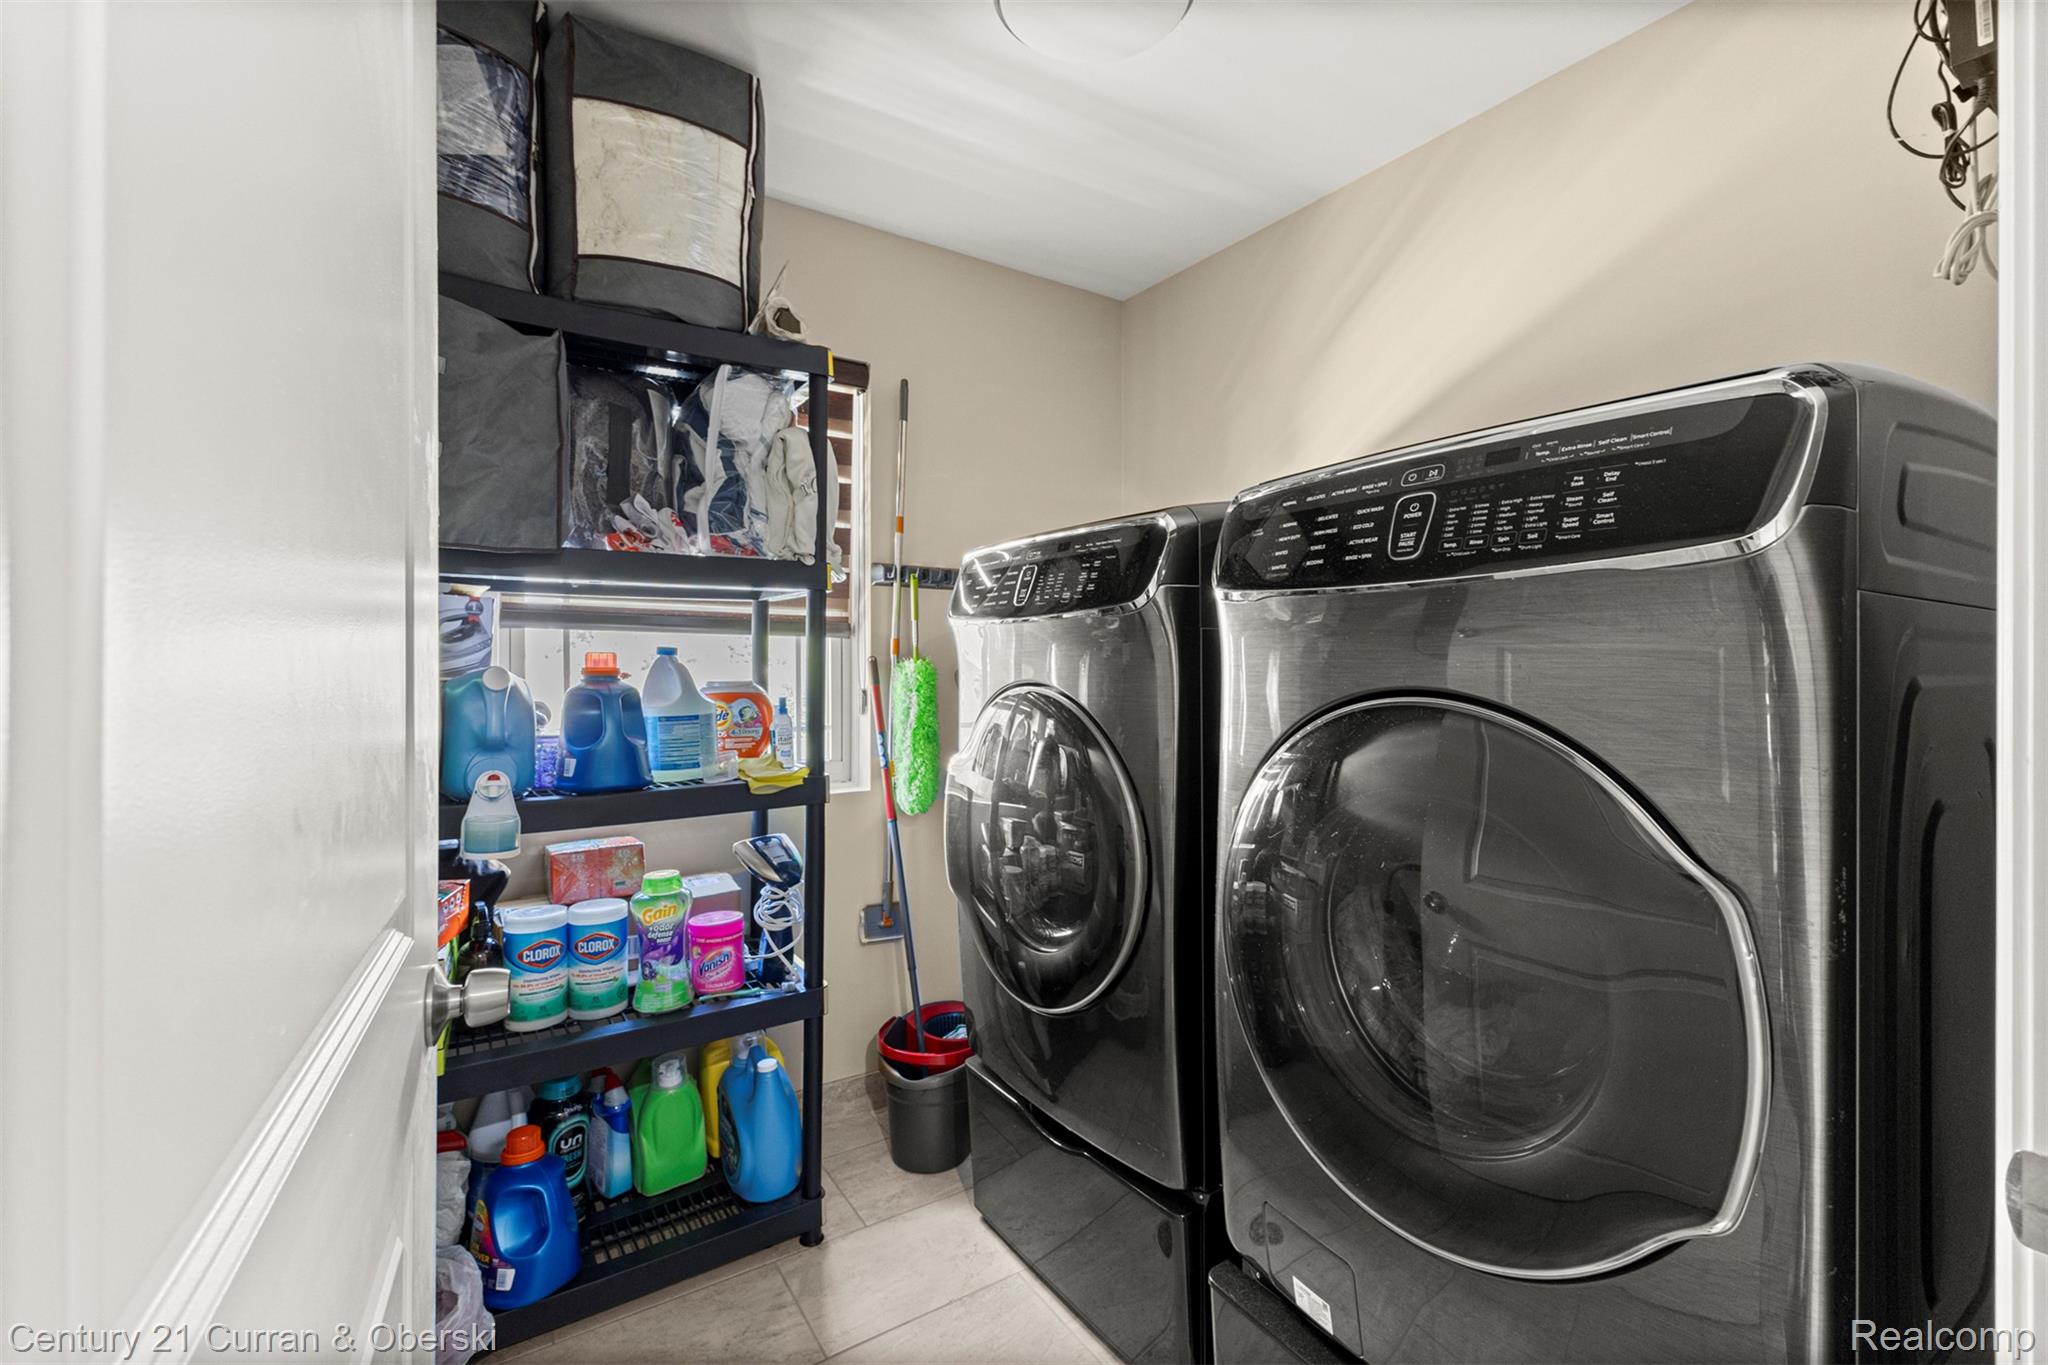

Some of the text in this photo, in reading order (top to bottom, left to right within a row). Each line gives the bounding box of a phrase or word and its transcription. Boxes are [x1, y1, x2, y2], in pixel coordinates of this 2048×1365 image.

[1632, 428, 1671, 440] Smart Control
[642, 904, 678, 926] Gain
[648, 930, 672, 939] defense
[523, 945, 560, 962] CLOROX
[577, 938, 614, 954] CLOROX
[698, 952, 730, 976] Vanish
